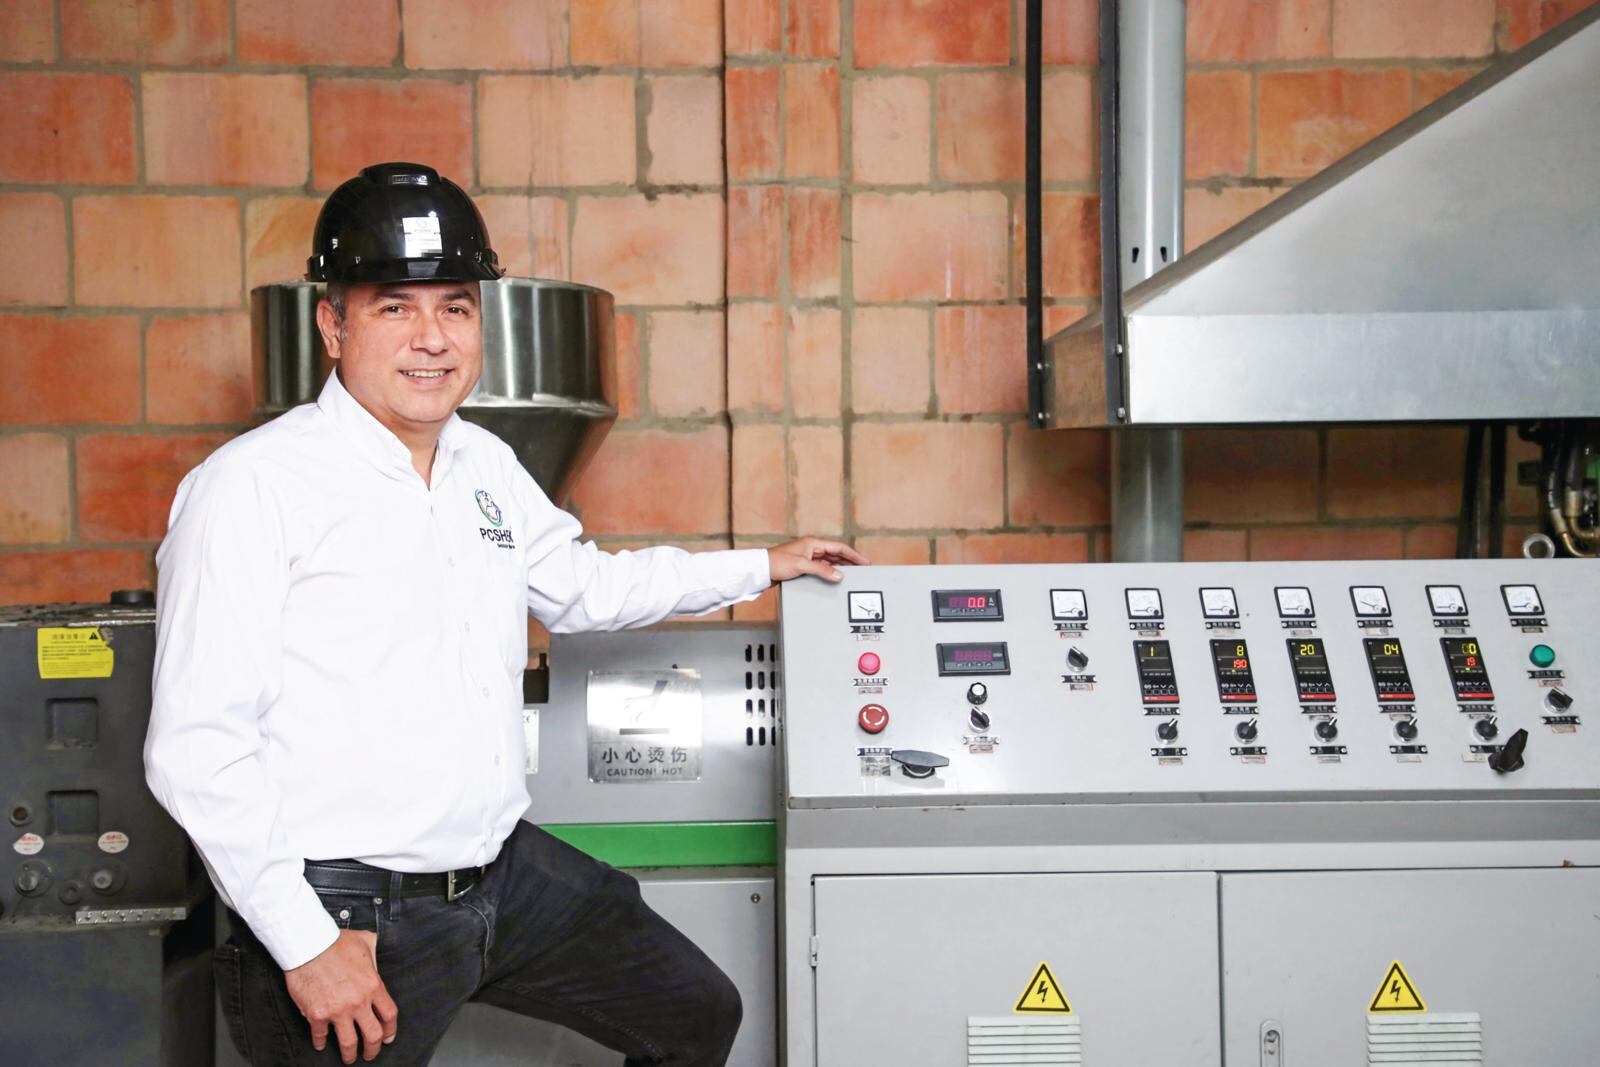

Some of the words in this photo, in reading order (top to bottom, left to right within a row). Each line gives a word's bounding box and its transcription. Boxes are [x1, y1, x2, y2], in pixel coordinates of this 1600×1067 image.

[1300, 644, 1315, 656] 20
[1384, 644, 1399, 656] 04
[1233, 659, 1248, 669] 190
[602, 747, 688, 764] 小心烫伤
[607, 768, 657, 776] CAUTION!
[662, 768, 683, 776] HOT
